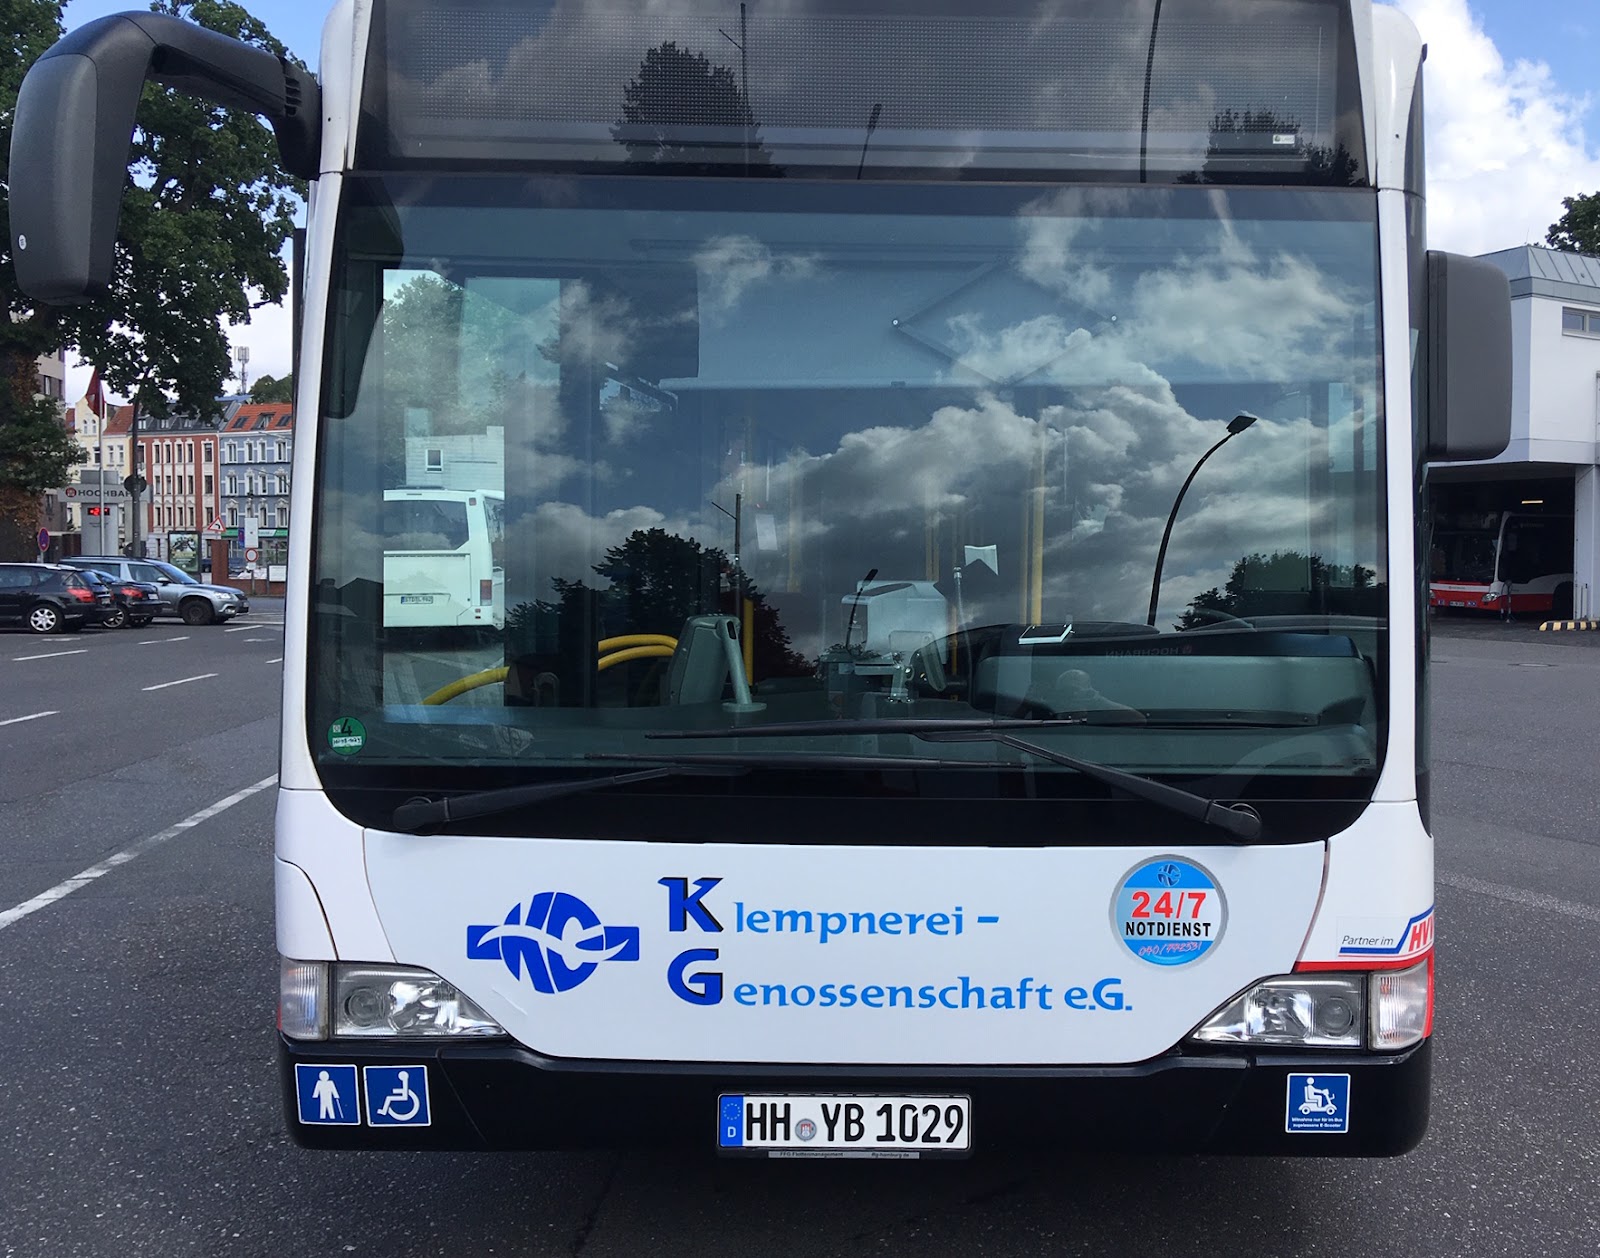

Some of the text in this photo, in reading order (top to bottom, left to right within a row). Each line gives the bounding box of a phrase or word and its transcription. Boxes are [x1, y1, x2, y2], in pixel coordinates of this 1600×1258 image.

[78, 489, 133, 498] HOCHBAH
[1131, 891, 1206, 920] 24/7
[1126, 921, 1211, 937] NOTDIENST
[1342, 935, 1378, 946] Partner
[1380, 936, 1394, 946] im
[1065, 978, 1133, 1011] e.G.
[746, 1102, 964, 1143] HH YB 1029
